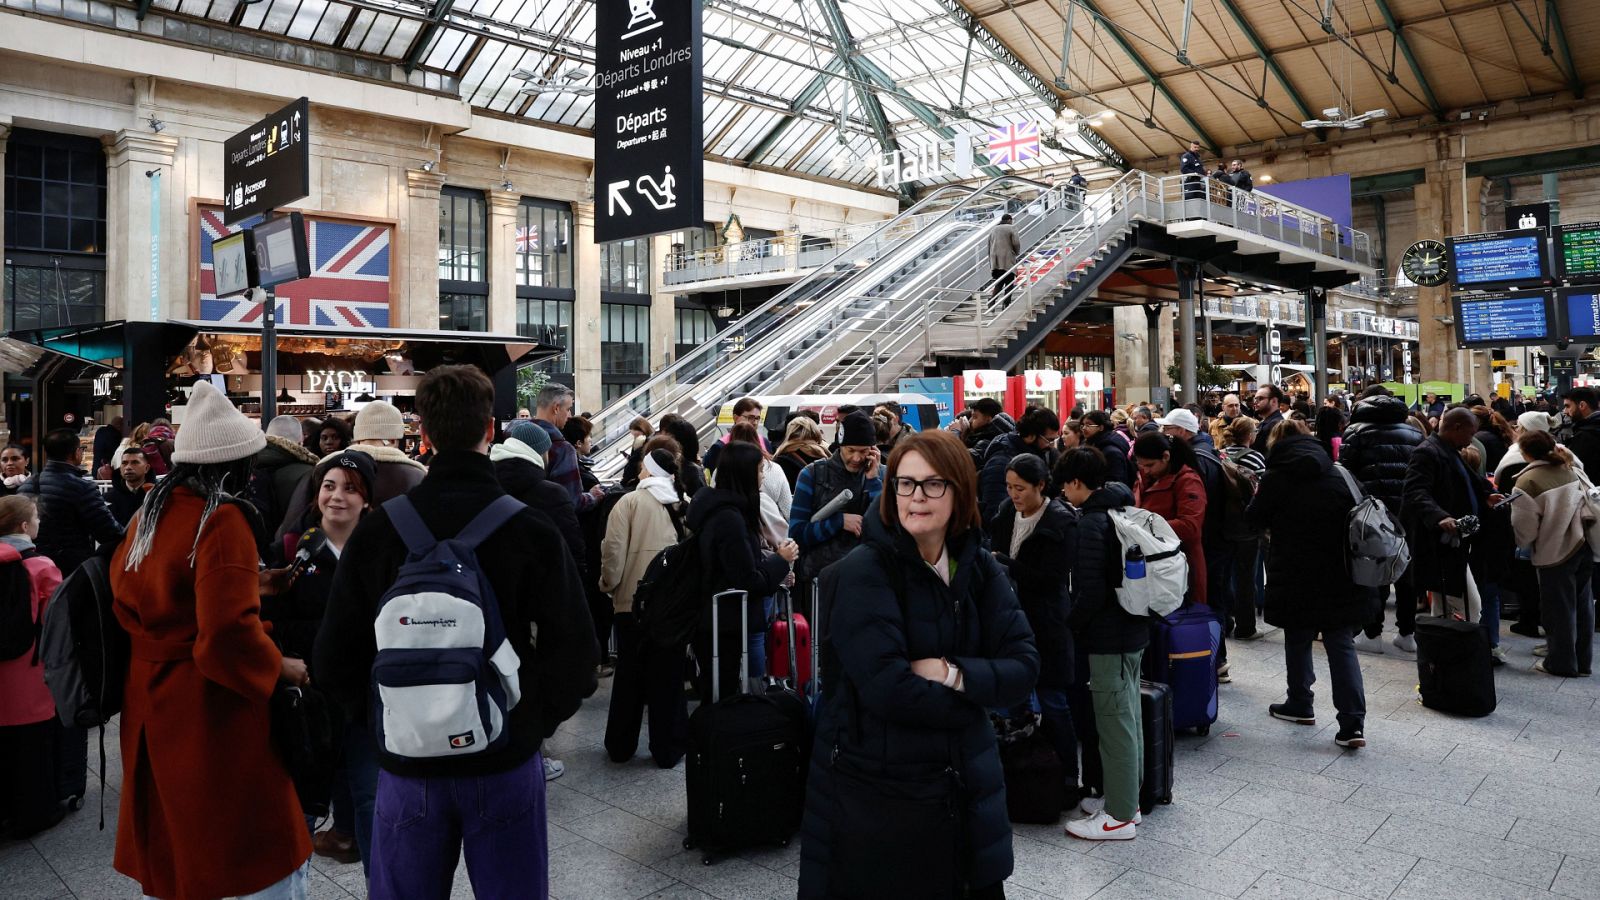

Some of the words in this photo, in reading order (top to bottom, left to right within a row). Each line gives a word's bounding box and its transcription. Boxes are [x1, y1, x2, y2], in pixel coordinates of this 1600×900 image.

[620, 44, 650, 63] Niveau
[651, 36, 662, 52] +1
[595, 64, 640, 88] Départs
[643, 46, 692, 74] Londres
[624, 85, 639, 98] Level
[616, 107, 667, 134] Départs
[232, 148, 248, 164] Départs
[248, 139, 266, 156] Londres
[616, 136, 648, 150] Departures
[878, 141, 942, 187] Hall
[244, 178, 267, 196] Ascenseur
[1591, 294, 1600, 336] information
[93, 378, 112, 396] PAUL
[399, 616, 456, 628] Champion
